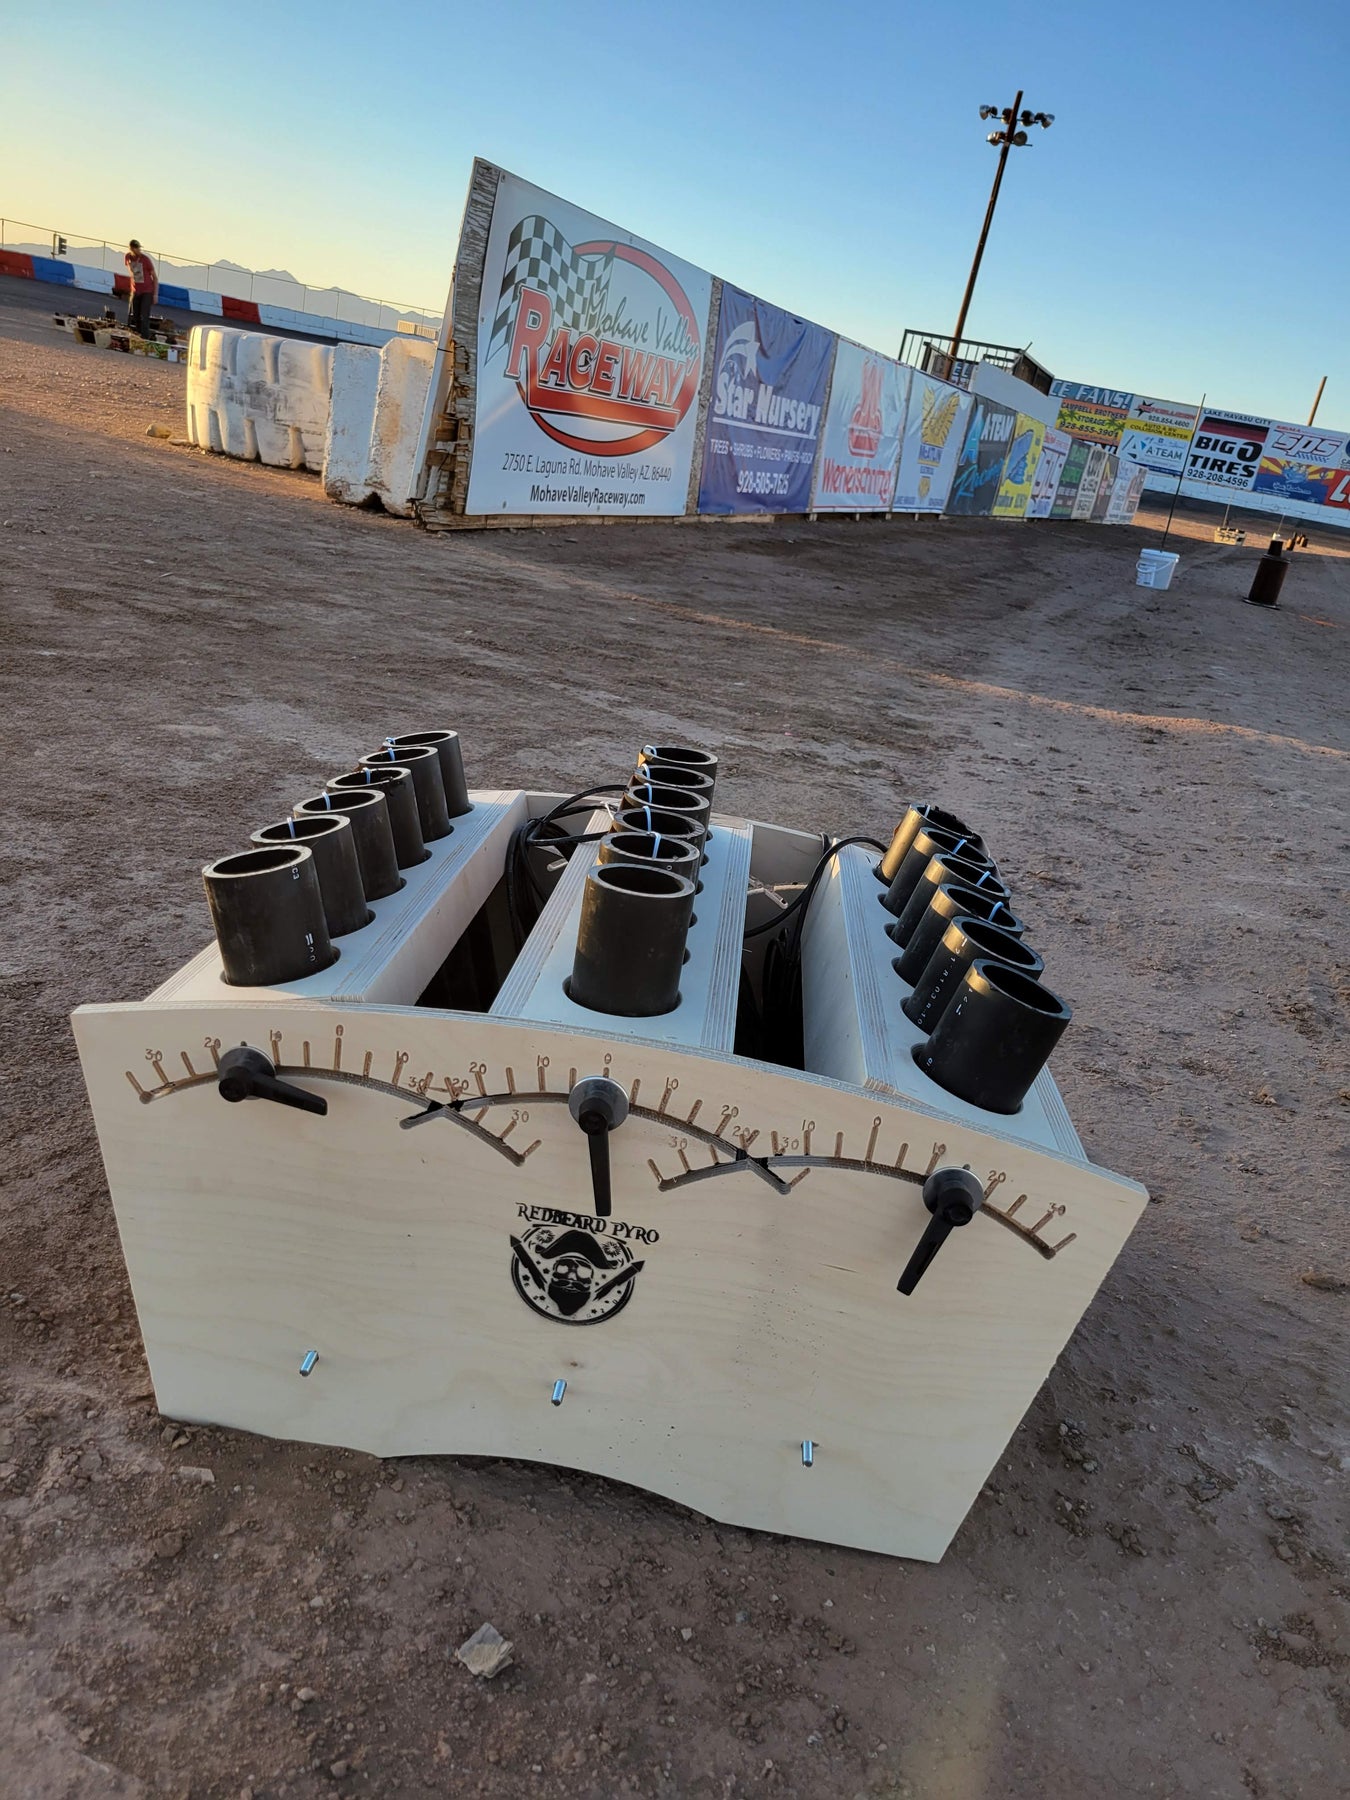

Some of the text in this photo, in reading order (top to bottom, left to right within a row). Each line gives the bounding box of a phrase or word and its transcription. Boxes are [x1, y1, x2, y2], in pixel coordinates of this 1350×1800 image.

[584, 281, 700, 376] Mohave Valley
[504, 284, 687, 407] RACEWAY
[1076, 385, 1133, 410] FANS!
[714, 373, 820, 439] Star Nursery
[1061, 402, 1093, 414] CAMPBELL
[1094, 408, 1128, 420] BROTHERS
[1076, 415, 1107, 427] STORAGE
[1204, 409, 1273, 426] LAKE HAVASU CITY
[1130, 424, 1189, 440] COLLISION CENTER
[1144, 422, 1161, 430] AUTO
[1194, 435, 1263, 463] BIG O
[502, 452, 525, 472] 2750
[526, 454, 534, 473] E.
[535, 456, 567, 479] Laguna
[569, 458, 582, 476] Rd.
[584, 460, 615, 479] Mohave
[617, 463, 638, 483] Valley
[651, 466, 672, 482] 86440
[1189, 454, 1257, 478] TIRES
[1187, 468, 1249, 488] 928-208-4596
[530, 484, 646, 508] MohaveValleyRaceway.com
[204, 1036, 222, 1050] 20
[144, 1048, 163, 1062] 30
[536, 1054, 550, 1068] 10
[604, 1052, 612, 1065] 0
[469, 1061, 487, 1075] 20
[665, 1076, 679, 1091] 10
[511, 1108, 530, 1123] 30
[721, 1104, 739, 1118] 20
[802, 1119, 816, 1132] 10
[873, 1115, 882, 1128] 0
[668, 1135, 688, 1149] 30
[782, 1135, 799, 1151] 30
[986, 1169, 1007, 1184] 20
[515, 1202, 660, 1245] REDBEARD PYRO
